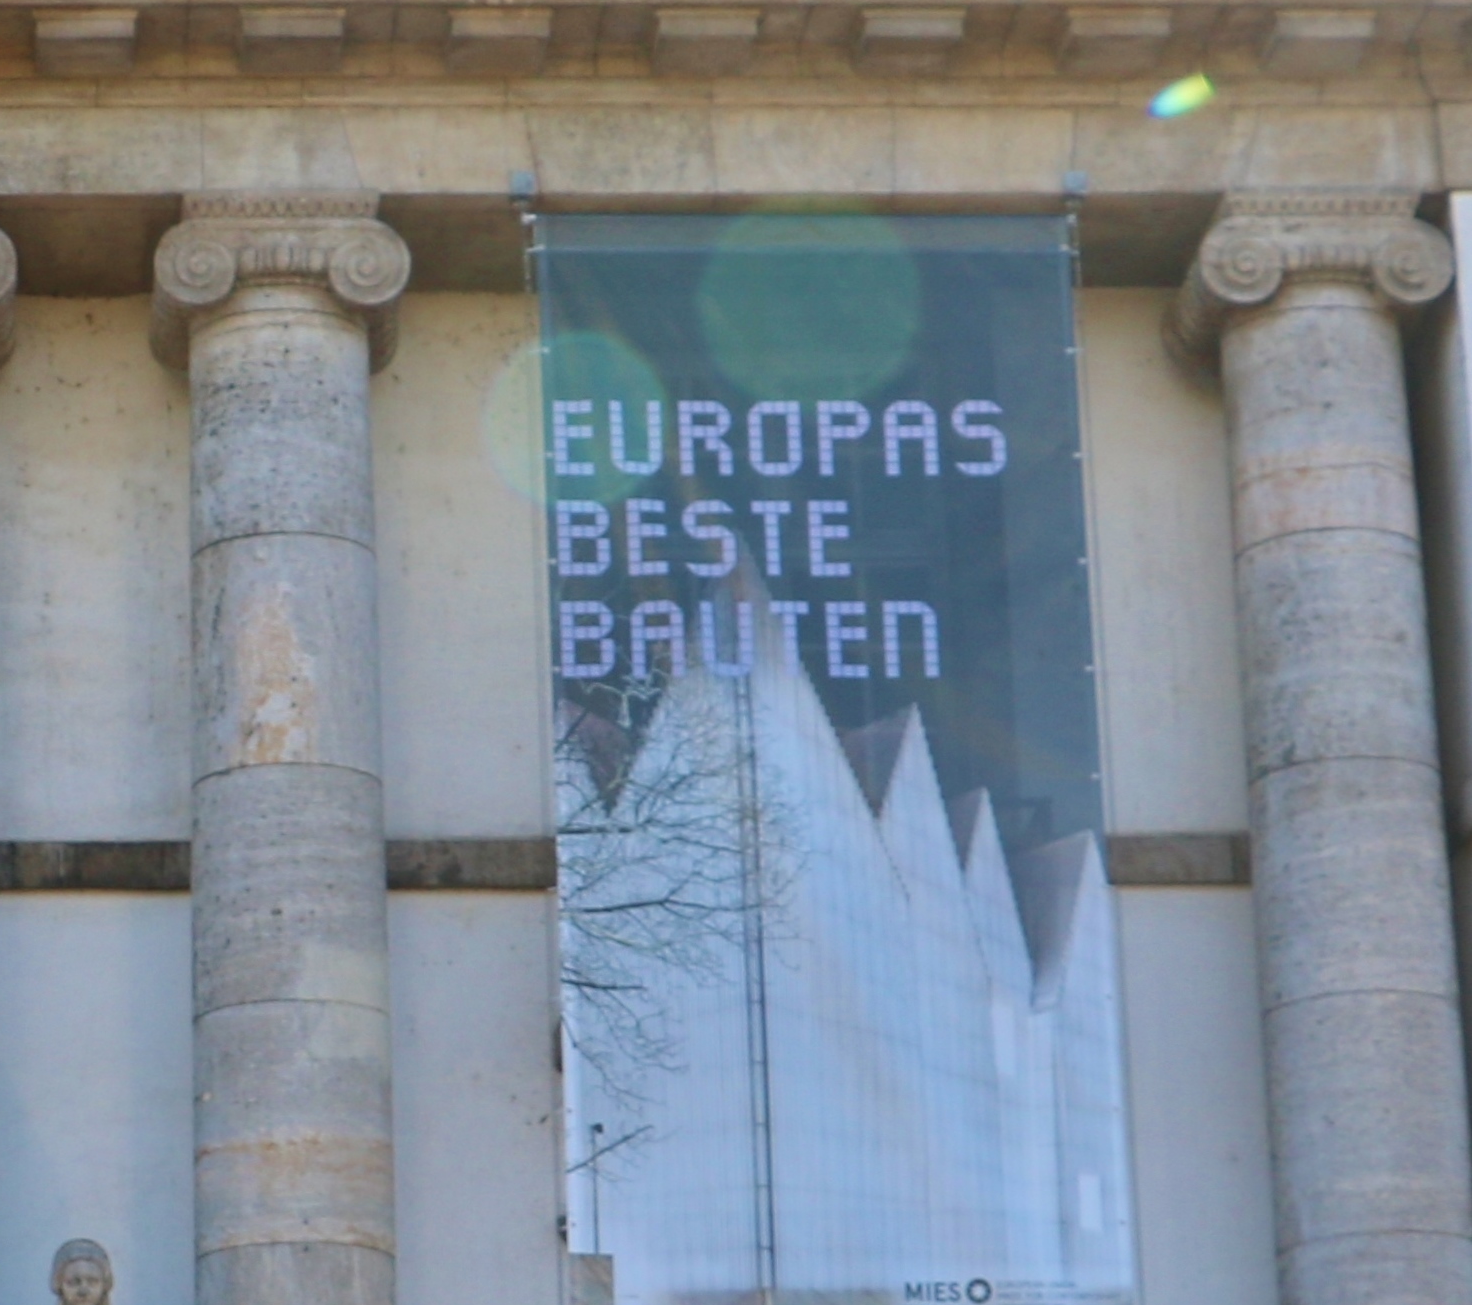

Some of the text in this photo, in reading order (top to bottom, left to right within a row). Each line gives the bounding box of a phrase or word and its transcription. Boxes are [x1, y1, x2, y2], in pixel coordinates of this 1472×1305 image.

[552, 399, 1007, 477] EUROPAS
[557, 499, 852, 578] BESTE
[560, 599, 941, 679] BAUTEN
[904, 1280, 961, 1303] MIES
